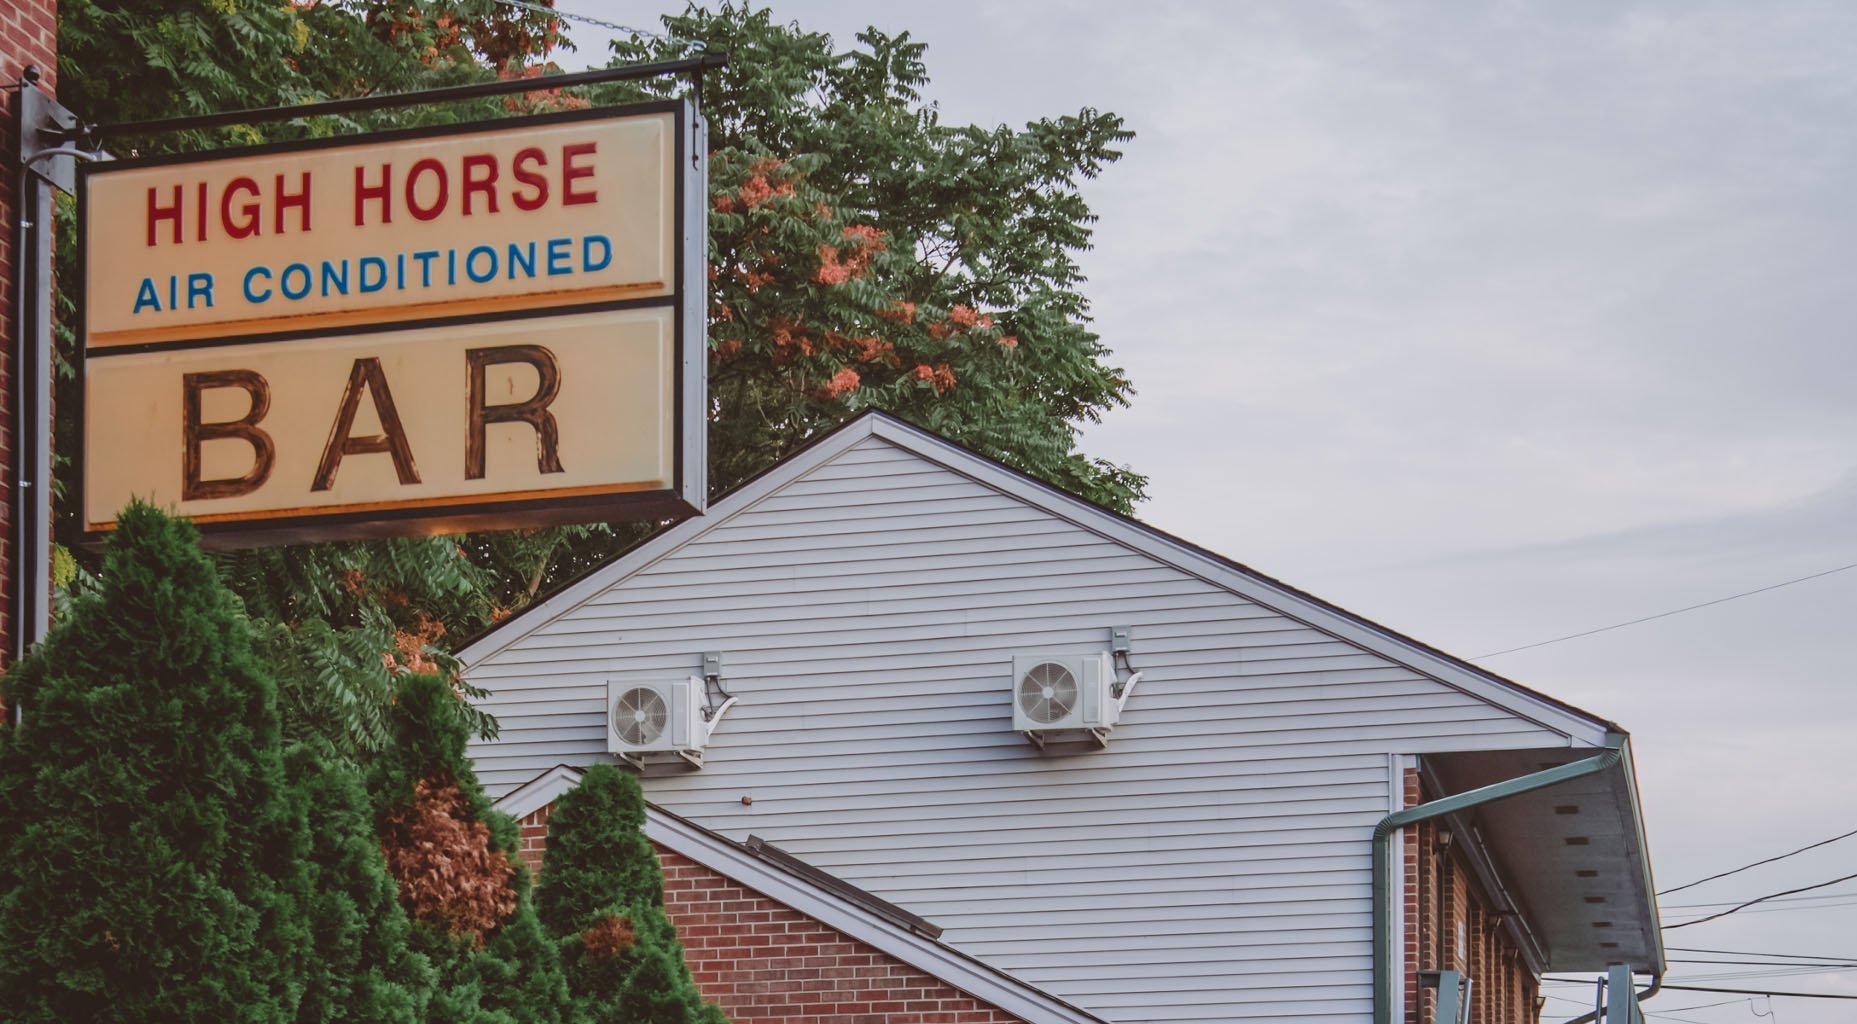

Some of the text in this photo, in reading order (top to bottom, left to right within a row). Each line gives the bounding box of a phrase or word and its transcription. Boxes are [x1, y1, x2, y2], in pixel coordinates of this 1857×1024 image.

[146, 142, 598, 247] HIGH HORSE
[134, 234, 613, 314] AIR CONDITIONED
[181, 343, 566, 503] BAR
